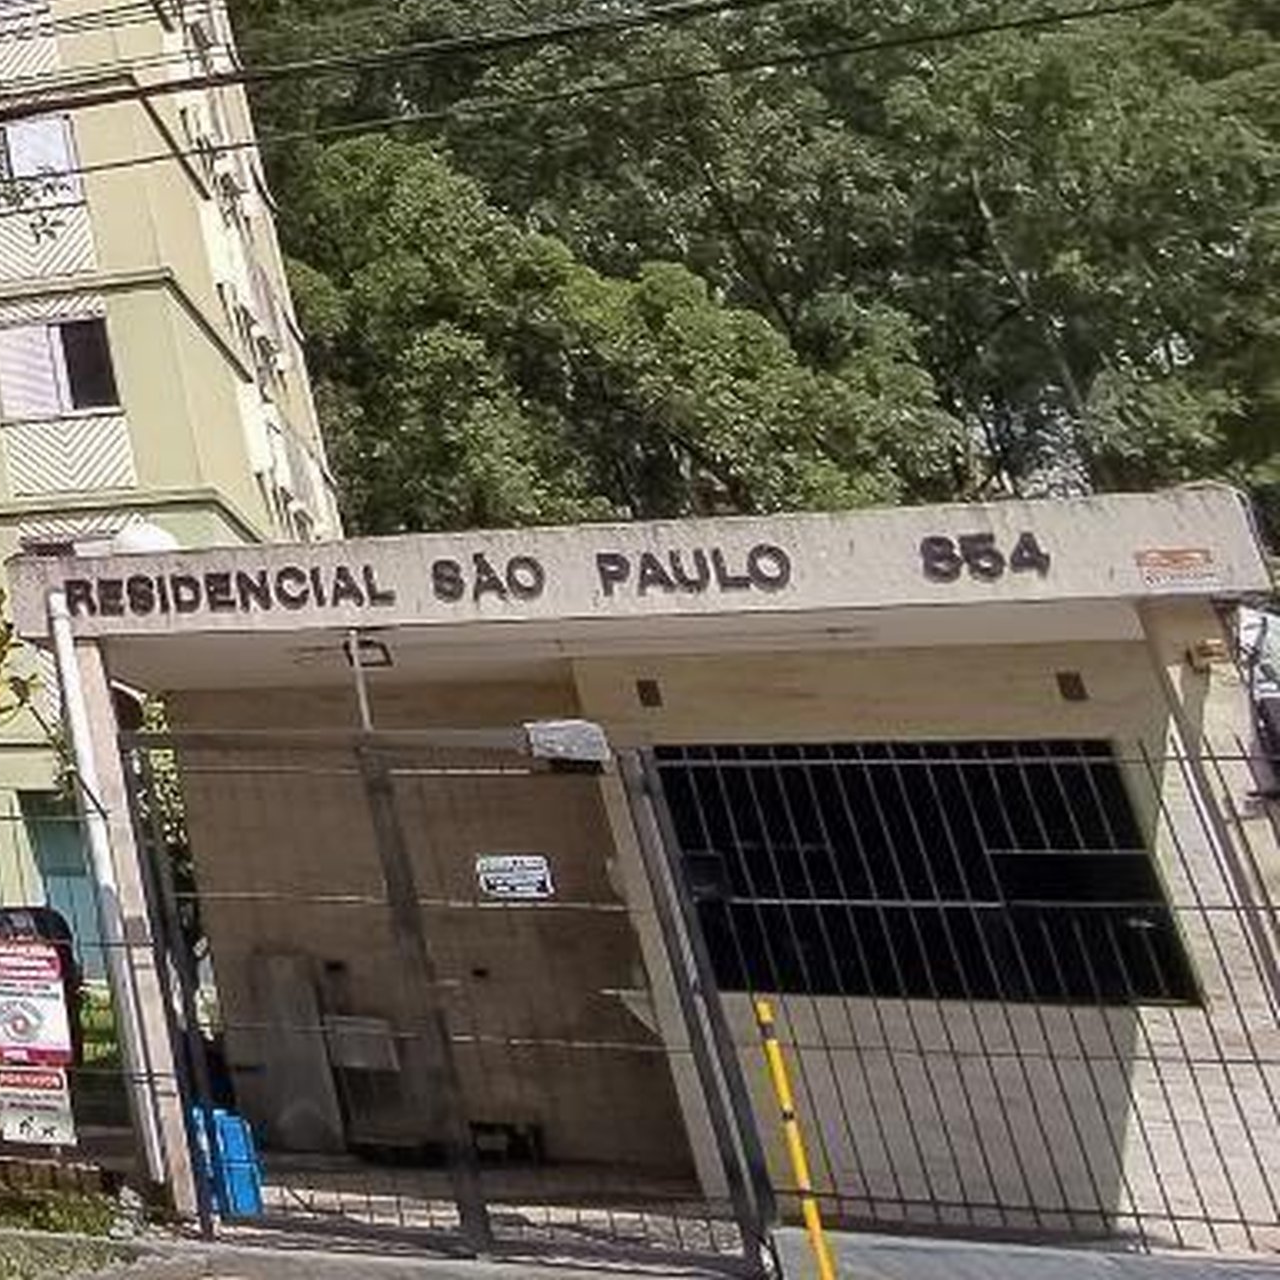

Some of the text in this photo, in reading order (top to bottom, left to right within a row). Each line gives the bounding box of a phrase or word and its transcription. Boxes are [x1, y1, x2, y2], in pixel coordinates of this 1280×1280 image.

[64, 565, 395, 616] RESIDENCIAL
[596, 543, 791, 596] PAULO
[920, 532, 1051, 584] 854
